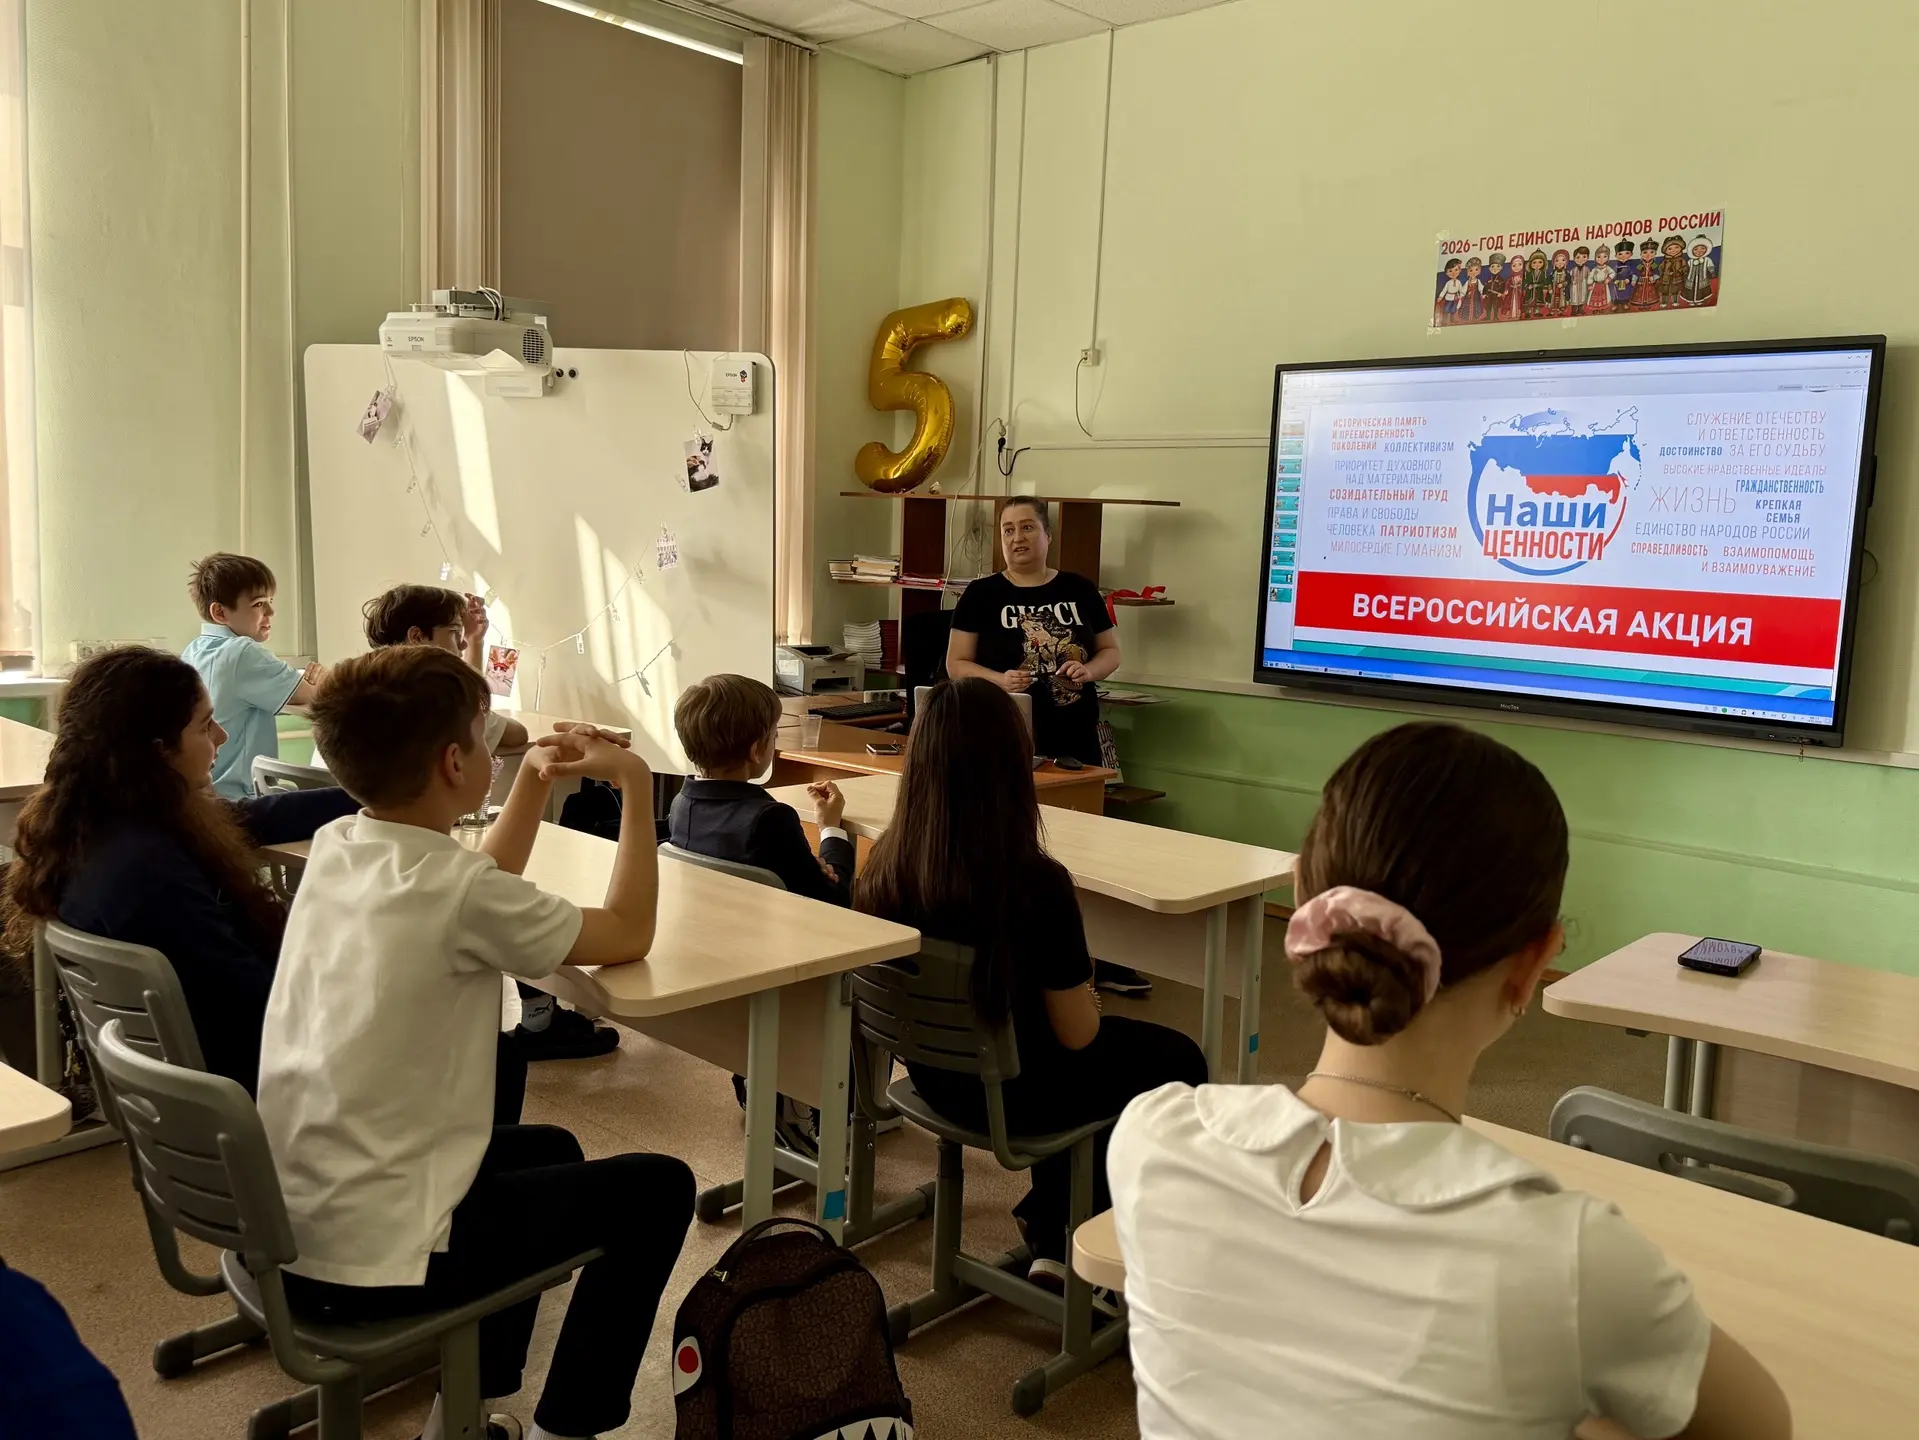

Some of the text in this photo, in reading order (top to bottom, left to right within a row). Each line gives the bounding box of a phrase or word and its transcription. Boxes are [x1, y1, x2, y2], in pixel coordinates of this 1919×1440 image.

[1441, 211, 1721, 255] 2026-ГОД ЕДИНСТВА НАРОДОВ РОССИИ
[1333, 416, 1427, 428] ИСТОРИЧЕСКАЯ ПАМЯТЬ
[1687, 411, 1827, 426] СЛУЖЕНИЕ ОТЕЧЕСТВУ
[1332, 428, 1415, 440] И ПРЕЕМСТВЕННОСТЬ
[1698, 427, 1825, 441] И ОТВЕТСТВЕННОСТЬ
[1332, 440, 1377, 451] ПОКОЛЕНИЙ
[1384, 441, 1454, 452] КОЛЛЕКТИВИЗМ
[1659, 446, 1723, 457] ДОСТОИНСТВО
[1729, 443, 1827, 457] ЗА ЕГО СУДЬБУ
[1335, 459, 1442, 471] ПРИОРИТЕТ ДУХОВНОГО
[1663, 464, 1827, 476] ВЫСОКИЕ НРАВСТВЕННЫЕ ИДЕАЛЫ
[1346, 473, 1442, 485] НАД МАТЕРИАЛЬНЫМ
[1735, 479, 1825, 494] ГРАЖДАНСТВЕННОСТЬ
[1329, 487, 1448, 502] СОЗИДАТЕЛЬНЫЙ ТРУД
[1649, 485, 1737, 514] ЖИЗНЬ
[1486, 494, 1607, 528] Наши
[1755, 499, 1802, 511] КРЕПКАЯ
[1327, 506, 1419, 521] ПРАВА И СВОБОДЫ
[1766, 512, 1801, 524] СЕМЬЯ
[1327, 523, 1375, 537] ЧЕЛОВЕКА
[1380, 525, 1457, 538] ПАТРИОТИЗМ
[1635, 521, 1811, 540] ЕДИНСТВО НАРОДОВ РОССИИ
[1330, 540, 1393, 555] МИЛОСЕРДИЕ
[1396, 542, 1462, 558] ГУМАНИЗМ
[1483, 529, 1605, 561] ЦЕННОСТИ
[1631, 542, 1708, 557] СПРАВЕДЛИВОСТЬ
[1723, 546, 1815, 562] ВЗАИМОПОМОЩЬ
[1701, 561, 1816, 577] И ВЗАИМОУВАЖЕНИЕ
[1353, 593, 1753, 647] ВСЕРОССИЙСКАЯ АКЦИЯ
